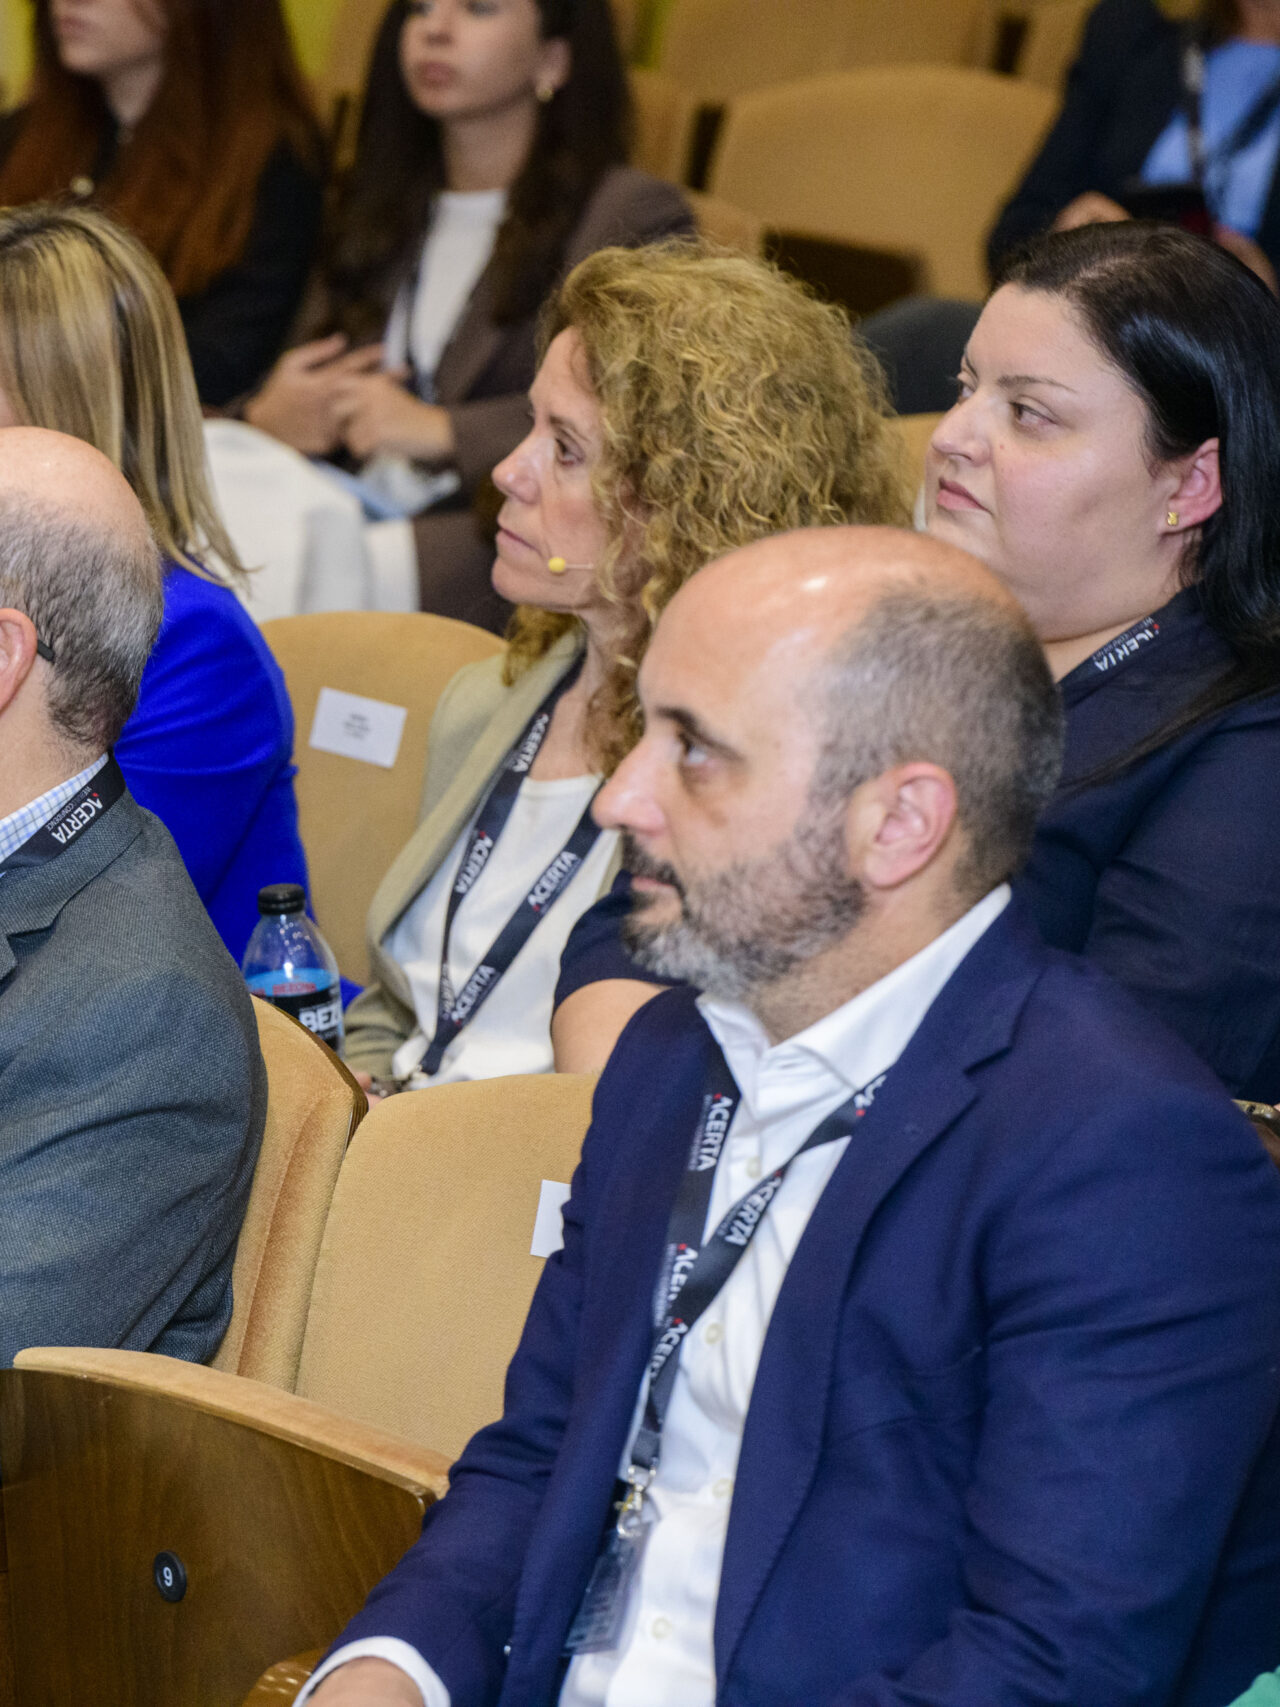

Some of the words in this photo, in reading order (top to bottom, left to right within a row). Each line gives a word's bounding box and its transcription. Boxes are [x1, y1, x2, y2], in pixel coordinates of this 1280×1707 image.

[51, 792, 103, 844] ACERTA
[455, 831, 493, 893] ACERTA
[528, 851, 578, 912] ACERTA
[451, 964, 495, 1026] ACERTA
[698, 1093, 732, 1171] ACERTA
[725, 1170, 783, 1246] ACERTA
[163, 1566, 173, 1587] 9
